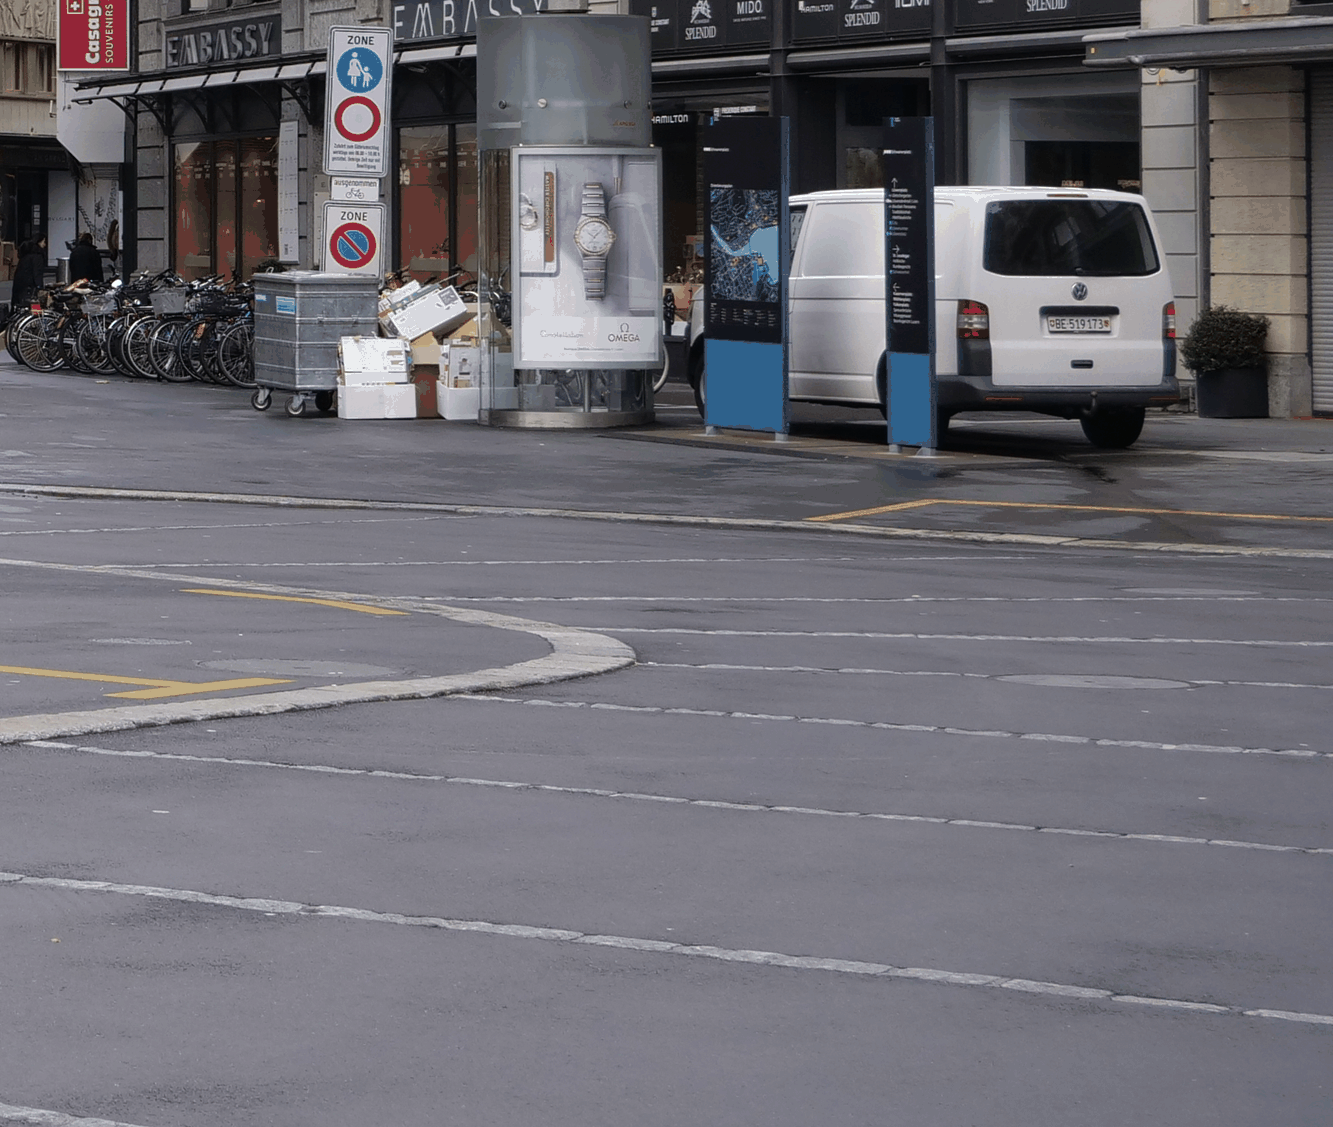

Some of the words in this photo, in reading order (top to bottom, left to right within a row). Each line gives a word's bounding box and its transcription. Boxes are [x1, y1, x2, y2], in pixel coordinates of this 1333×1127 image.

[736, 0, 762, 15] MIDO
[800, 4, 834, 13] HAMILTON
[844, 11, 880, 27] SPLENDID
[104, 3, 115, 64] SOUVENIRS
[685, 26, 717, 40] SPLENDID
[167, 22, 272, 68] EMBASSY
[347, 35, 375, 45] ZONE
[334, 179, 377, 188] ausgenommen
[340, 211, 368, 222] ZONE
[607, 334, 641, 343] OMEGA
